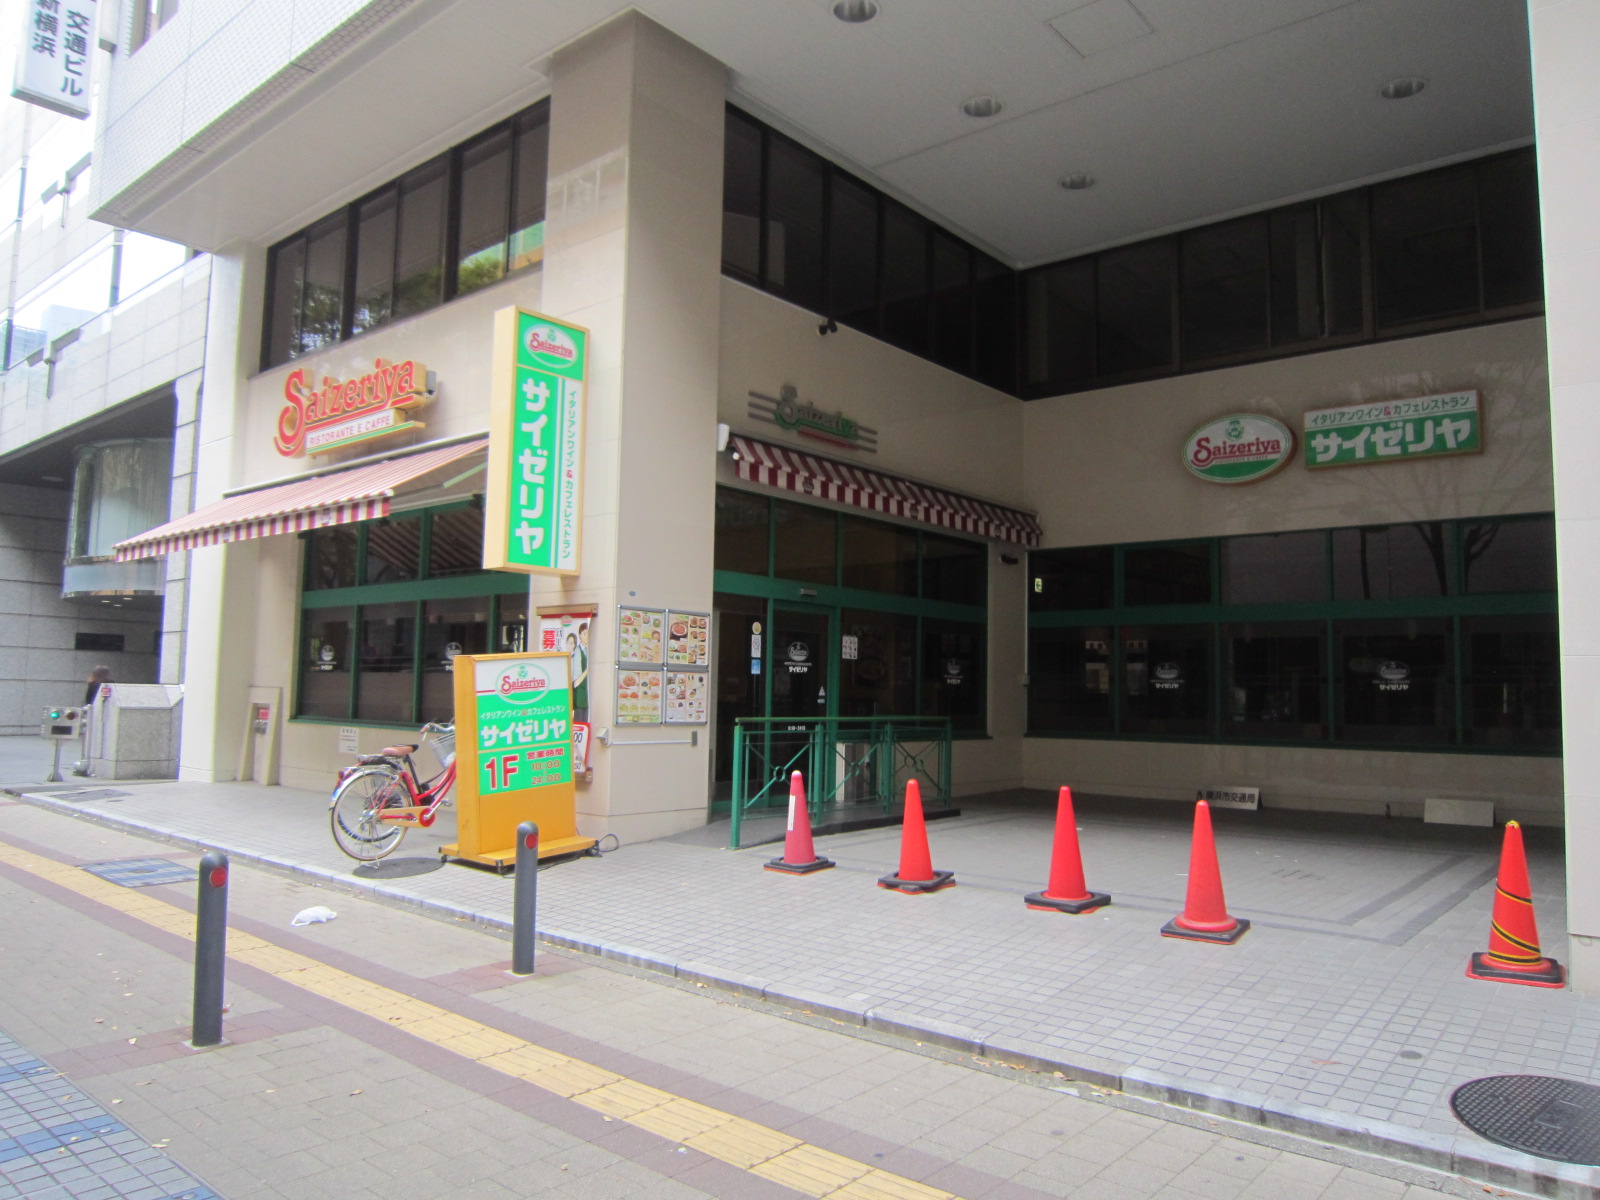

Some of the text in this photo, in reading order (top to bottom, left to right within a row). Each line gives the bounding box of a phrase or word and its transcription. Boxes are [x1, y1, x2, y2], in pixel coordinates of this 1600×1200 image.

[60, 9, 91, 97] 交通ビル
[273, 357, 415, 458] Saizeriya
[309, 427, 355, 446] RISTORANTE
[357, 424, 363, 433] E
[1190, 436, 1282, 468] Saizeriya
[1310, 418, 1472, 463] サイゼリヤ
[515, 377, 549, 555] サイゼリヤ
[500, 675, 546, 695] Saizeriya
[480, 718, 567, 747] サイゼリヤ
[485, 754, 520, 790] 1F
[1206, 790, 1256, 804] 横浜市交通局
